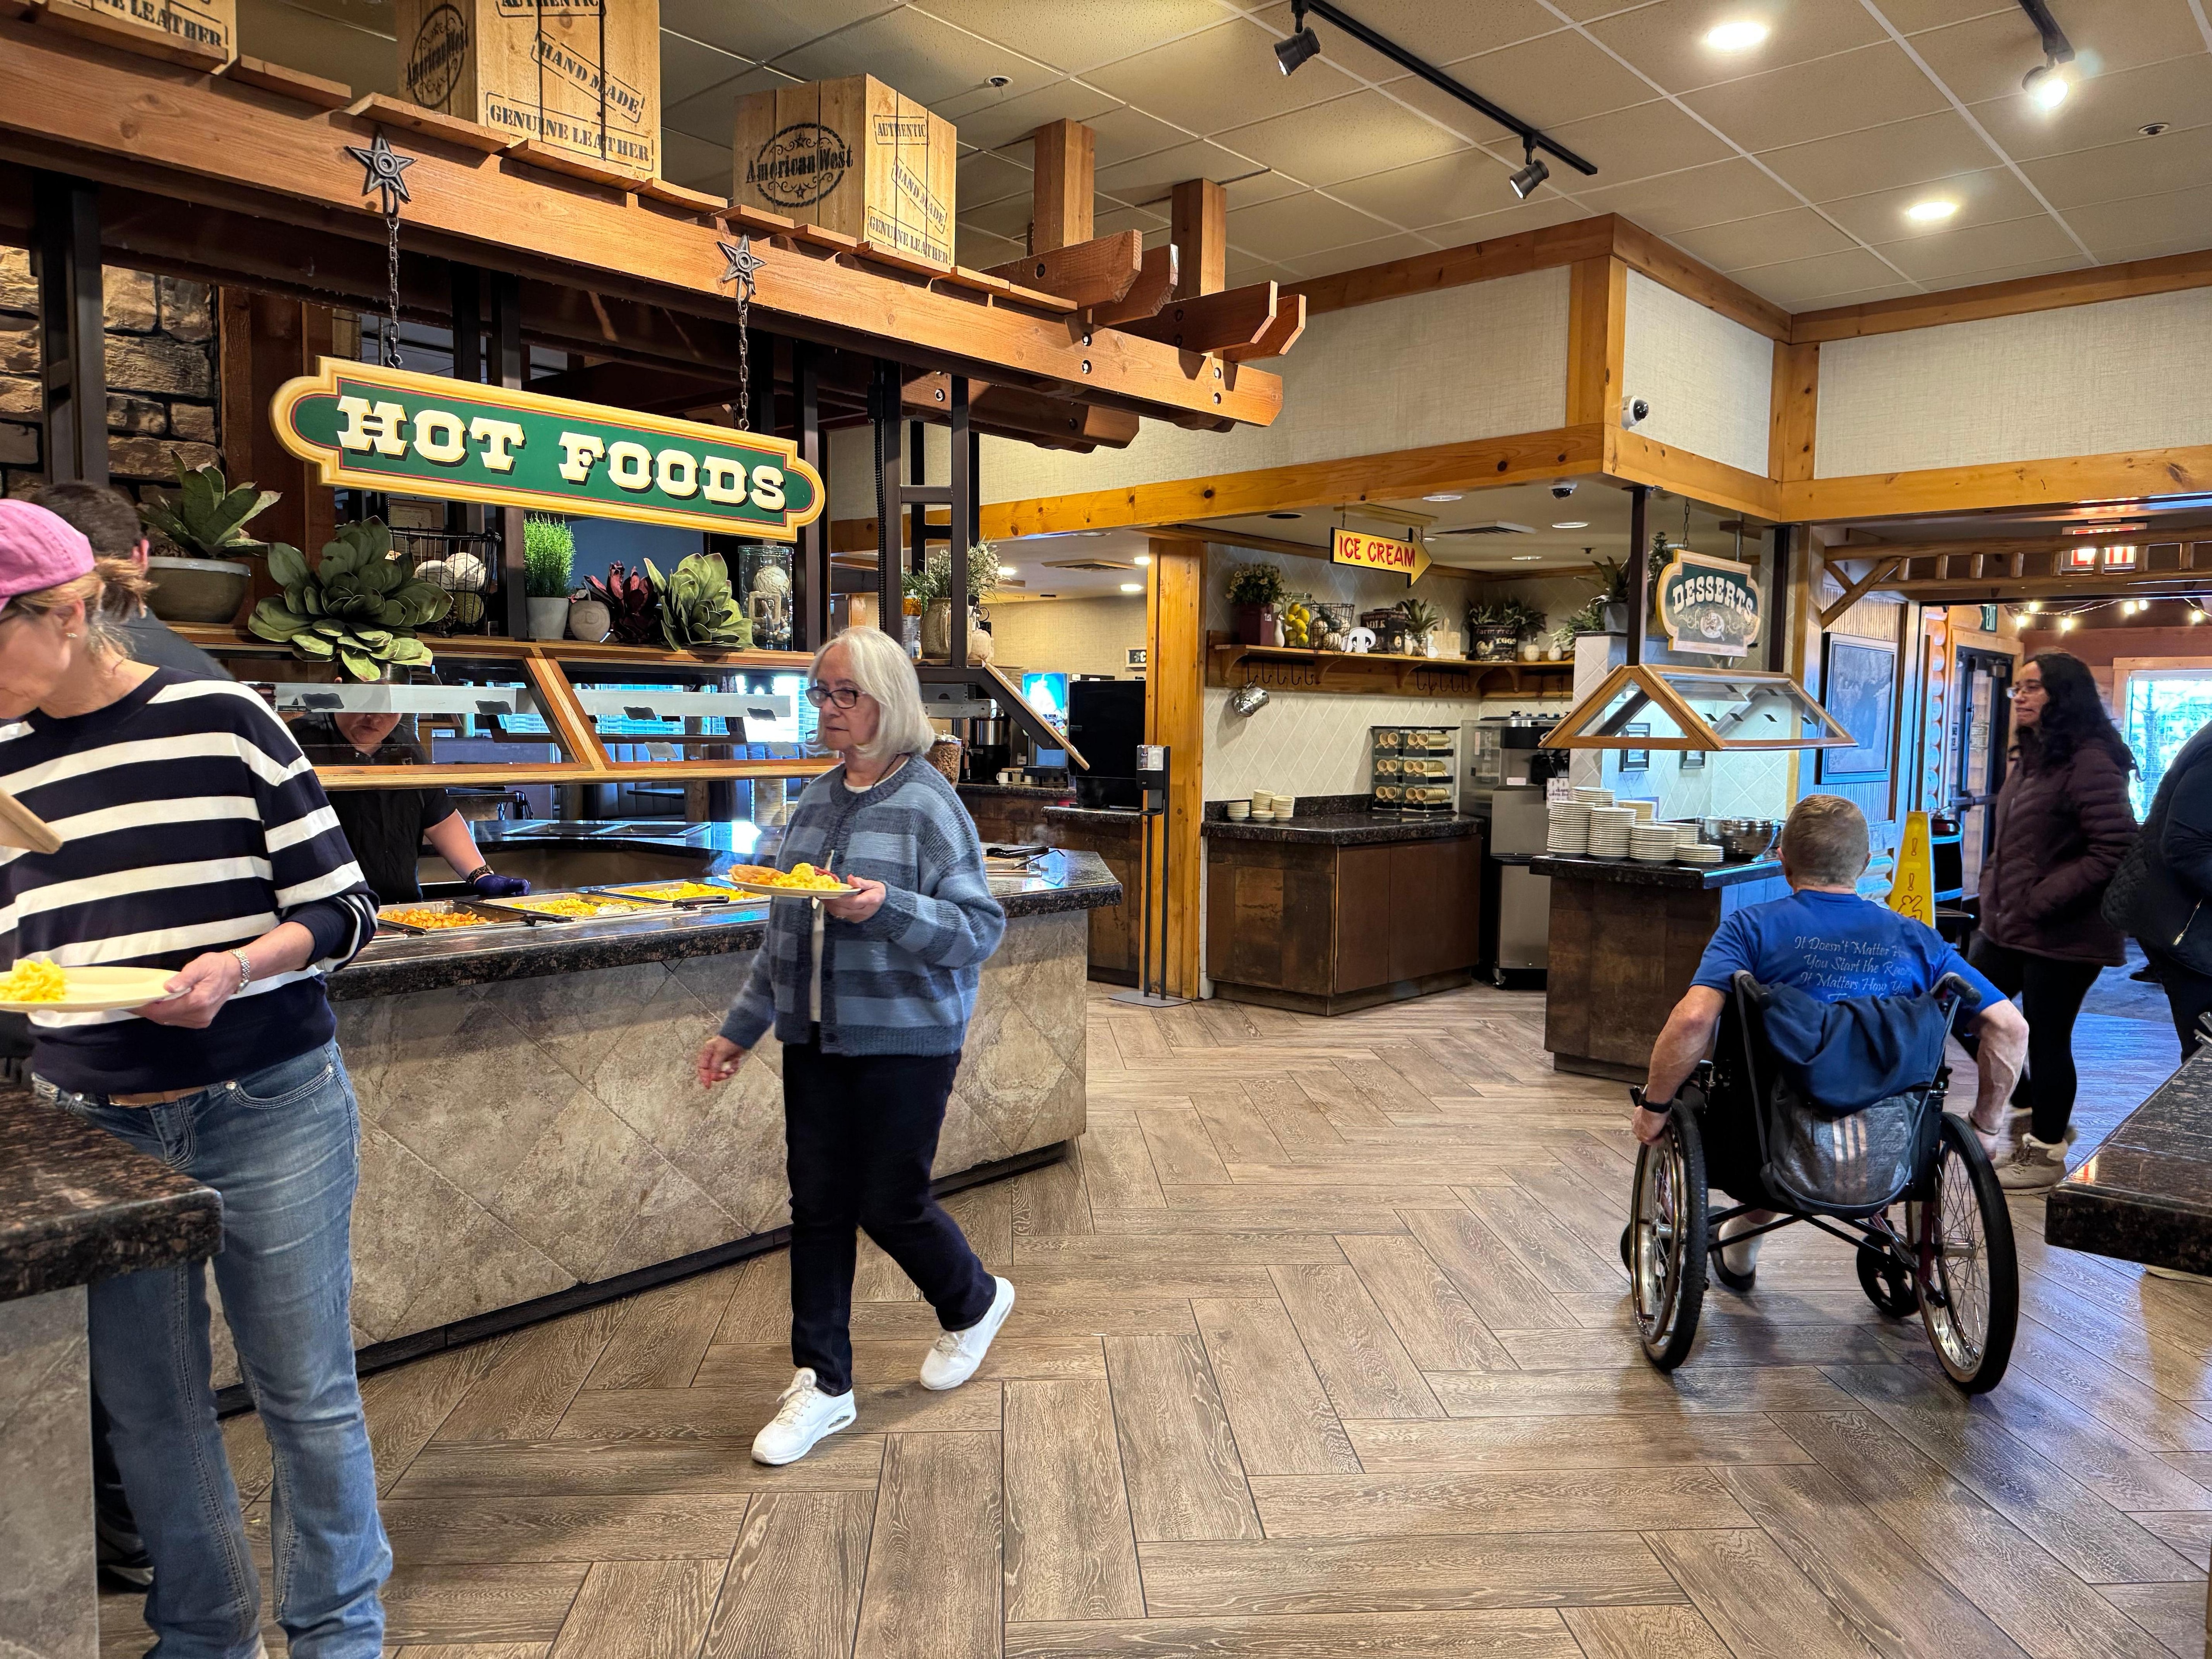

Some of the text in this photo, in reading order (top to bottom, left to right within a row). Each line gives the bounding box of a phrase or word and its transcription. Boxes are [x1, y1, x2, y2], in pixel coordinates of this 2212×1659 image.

[540, 41, 640, 114] HAND MADE
[490, 104, 649, 162] GENUINE LEATHER
[878, 122, 926, 138] AUTHENTIC
[746, 143, 853, 184] American West
[896, 164, 944, 227] HAND MADE
[869, 216, 948, 264] GENUINE LEATHER
[336, 395, 787, 512] HOT FOODS
[1339, 535, 1415, 568] ICE CREAM
[1672, 576, 1753, 624] DESSERTS
[1794, 936, 1806, 949] It
[1809, 937, 1848, 953] Doesn't
[1851, 941, 1890, 956] Matter
[1803, 954, 1828, 969] You
[1831, 956, 1861, 972] Start
[1863, 957, 1879, 973] the
[1815, 973, 1859, 990] Matters
[1862, 978, 1887, 991] How
